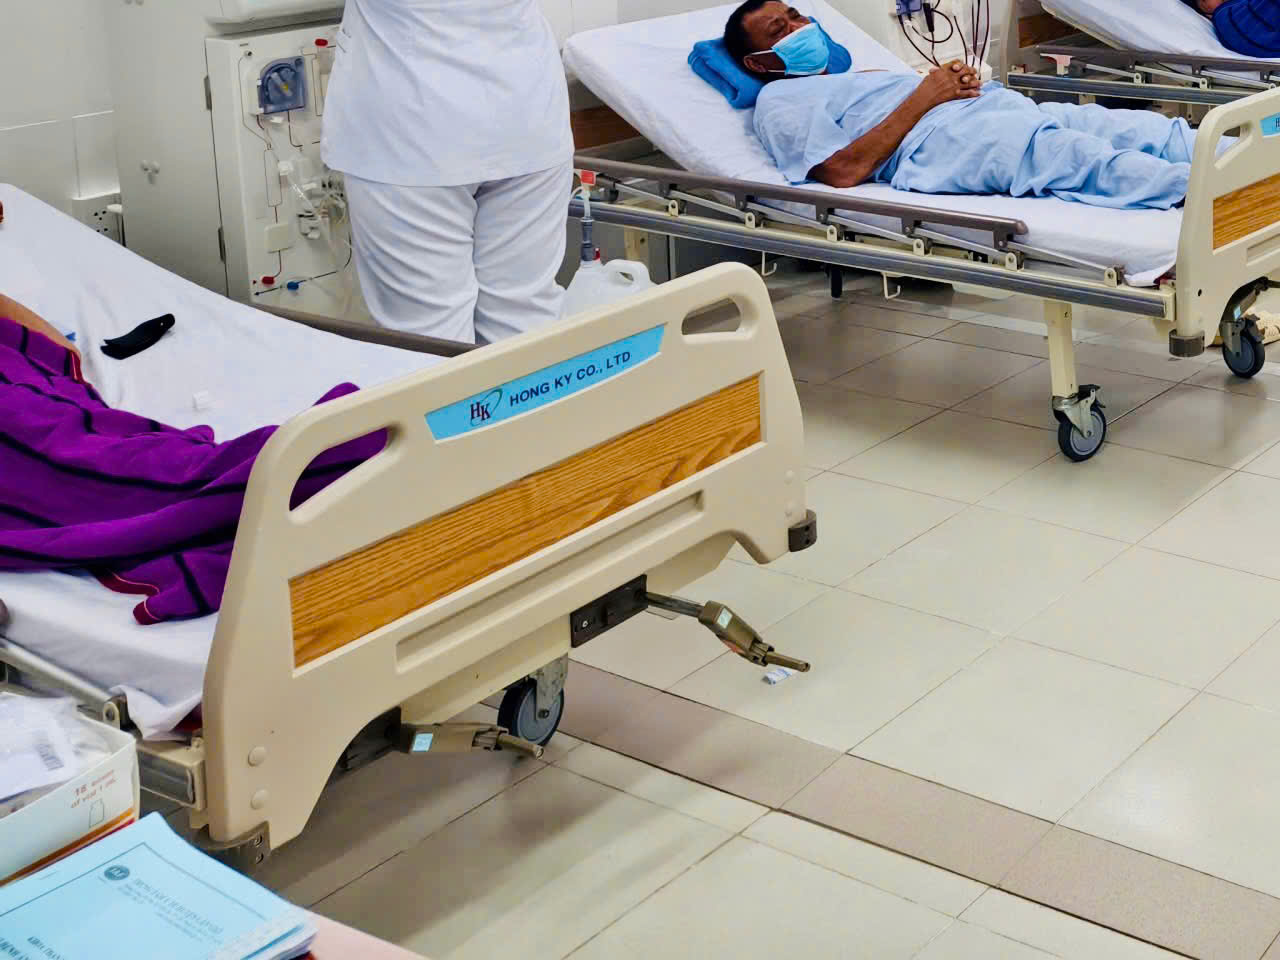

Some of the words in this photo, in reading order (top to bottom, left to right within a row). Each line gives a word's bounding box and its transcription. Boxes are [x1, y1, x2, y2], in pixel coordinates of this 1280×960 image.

[510, 382, 550, 407] HONG
[554, 373, 573, 390] KY
[606, 351, 631, 369] LTD
